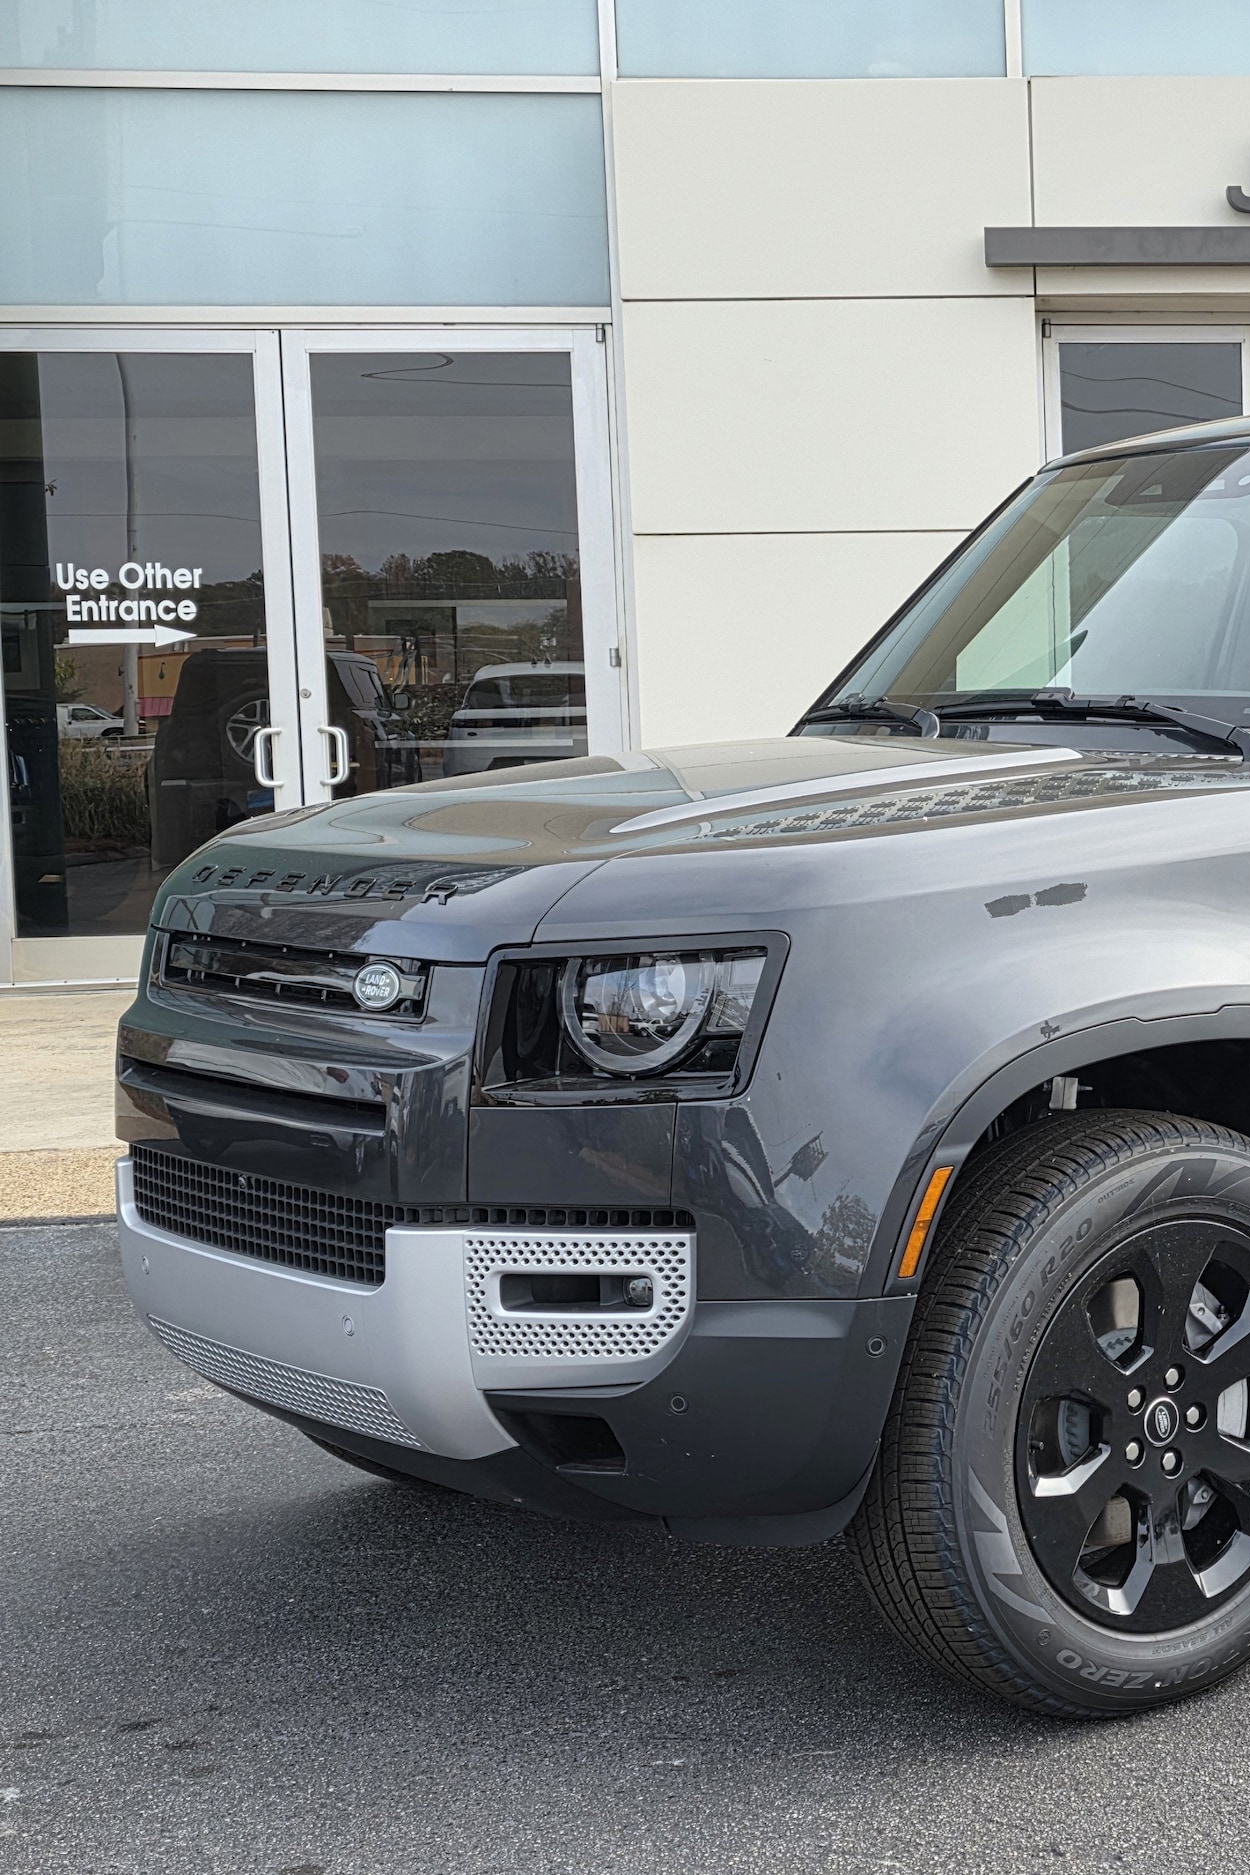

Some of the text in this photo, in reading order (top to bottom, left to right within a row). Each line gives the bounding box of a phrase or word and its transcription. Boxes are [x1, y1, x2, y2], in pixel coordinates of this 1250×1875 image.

[56, 562, 203, 590] Use Other
[66, 594, 197, 621] Entrance
[192, 863, 459, 906] DEFENDER
[984, 1290, 1035, 1440] 255/60
[1039, 1217, 1093, 1289] R20
[1152, 1616, 1234, 1655] ALL SEASON
[1056, 1648, 1154, 1689] ZERO
